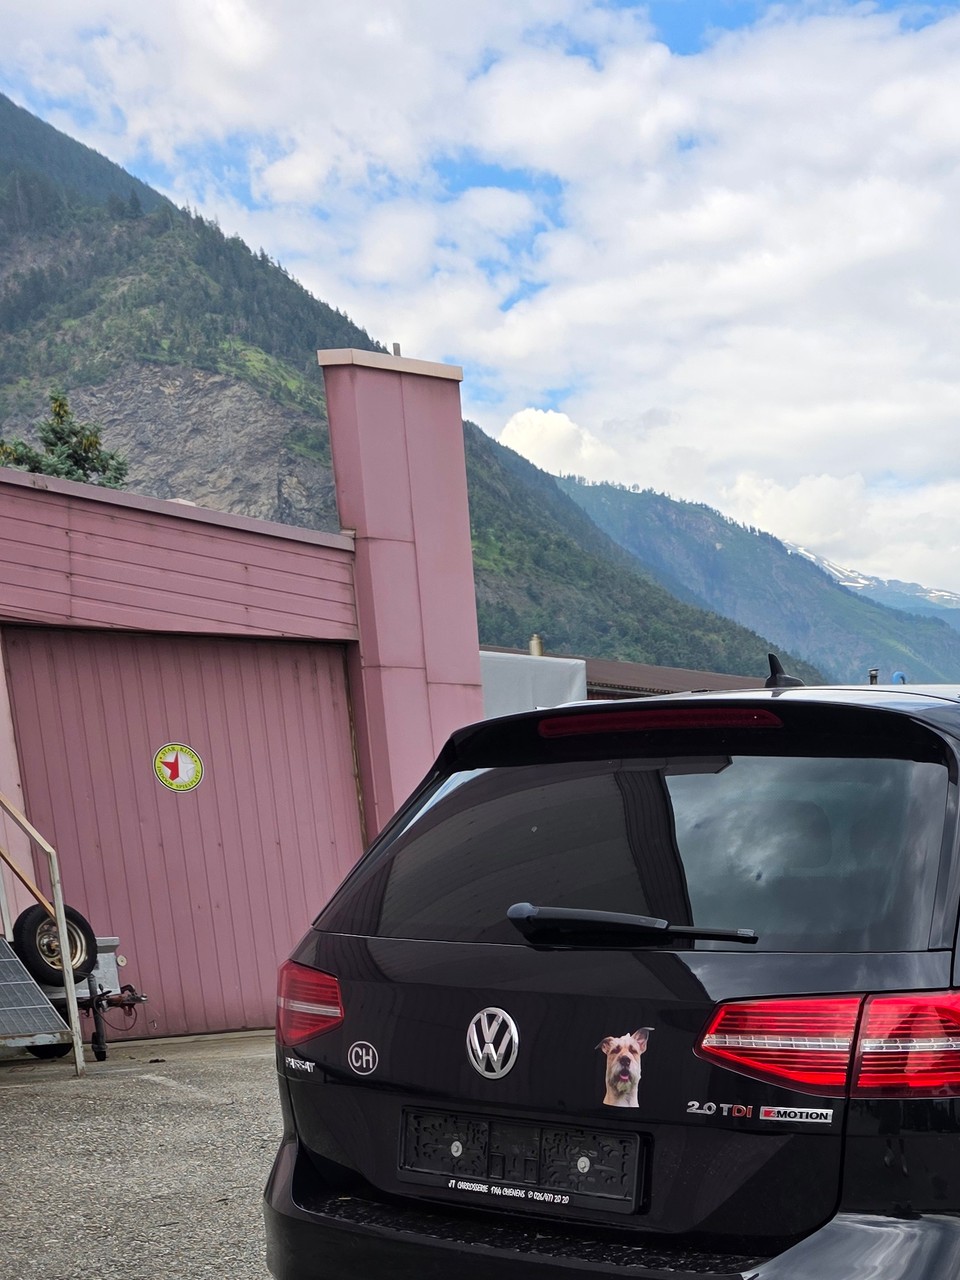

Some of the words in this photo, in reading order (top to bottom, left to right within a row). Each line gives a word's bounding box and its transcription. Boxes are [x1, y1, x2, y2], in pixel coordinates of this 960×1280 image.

[351, 1047, 373, 1069] CH
[686, 1100, 717, 1115] 2.0
[720, 1103, 753, 1118] TDI
